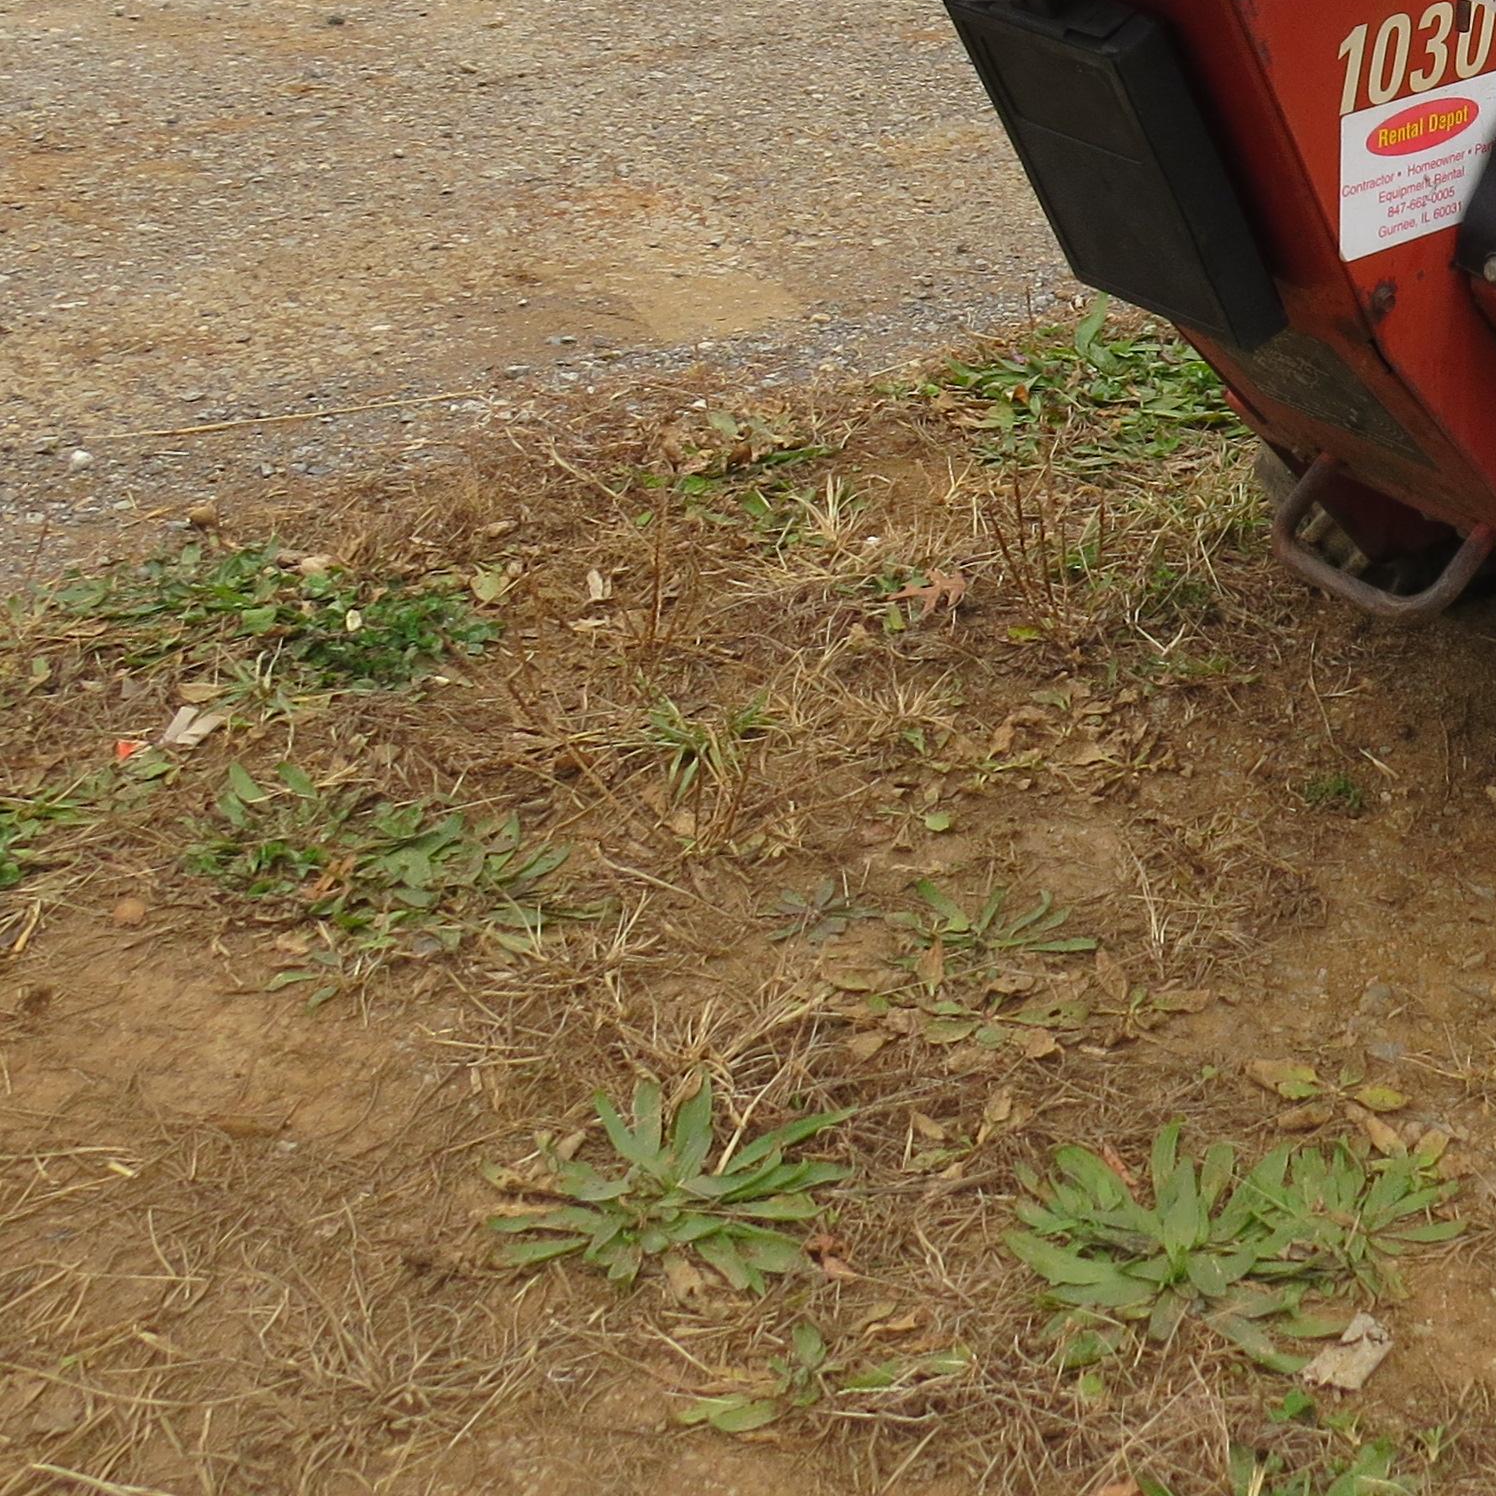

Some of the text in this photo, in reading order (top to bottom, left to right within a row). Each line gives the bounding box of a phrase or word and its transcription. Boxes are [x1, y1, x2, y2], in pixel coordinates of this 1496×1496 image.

[1338, 1, 1496, 116] 1030
[1378, 105, 1469, 148] Rental Depot
[1342, 172, 1395, 198] Contractor
[1407, 151, 1465, 177] Homeowner
[1378, 166, 1465, 204] Equipment Rental
[1421, 212, 1431, 224] IL
[1433, 201, 1463, 220] 60031
